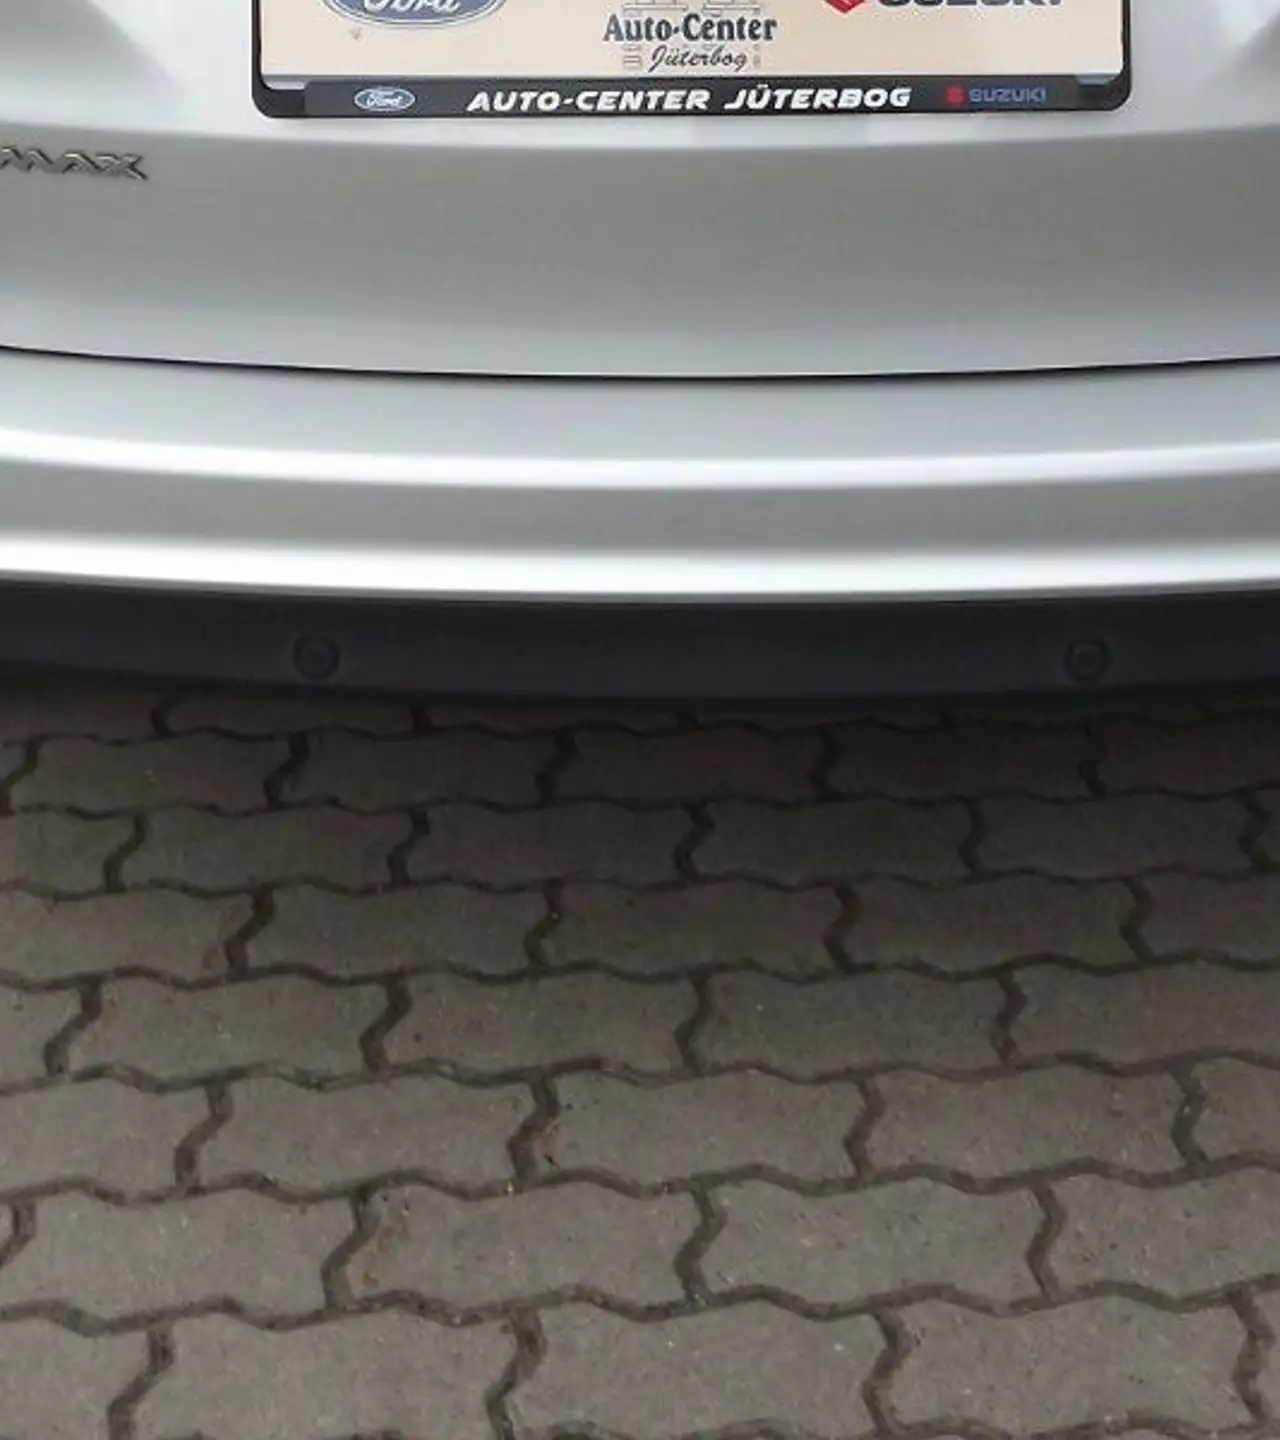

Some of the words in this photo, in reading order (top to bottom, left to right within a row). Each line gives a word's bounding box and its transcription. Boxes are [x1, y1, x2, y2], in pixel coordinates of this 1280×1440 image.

[602, 12, 778, 44] Auto-Center
[646, 44, 749, 73] Jüterbog
[465, 88, 712, 113] AUTO-CENTER
[723, 83, 912, 111] JÜTERBOG
[968, 86, 1048, 104] SUZUKI
